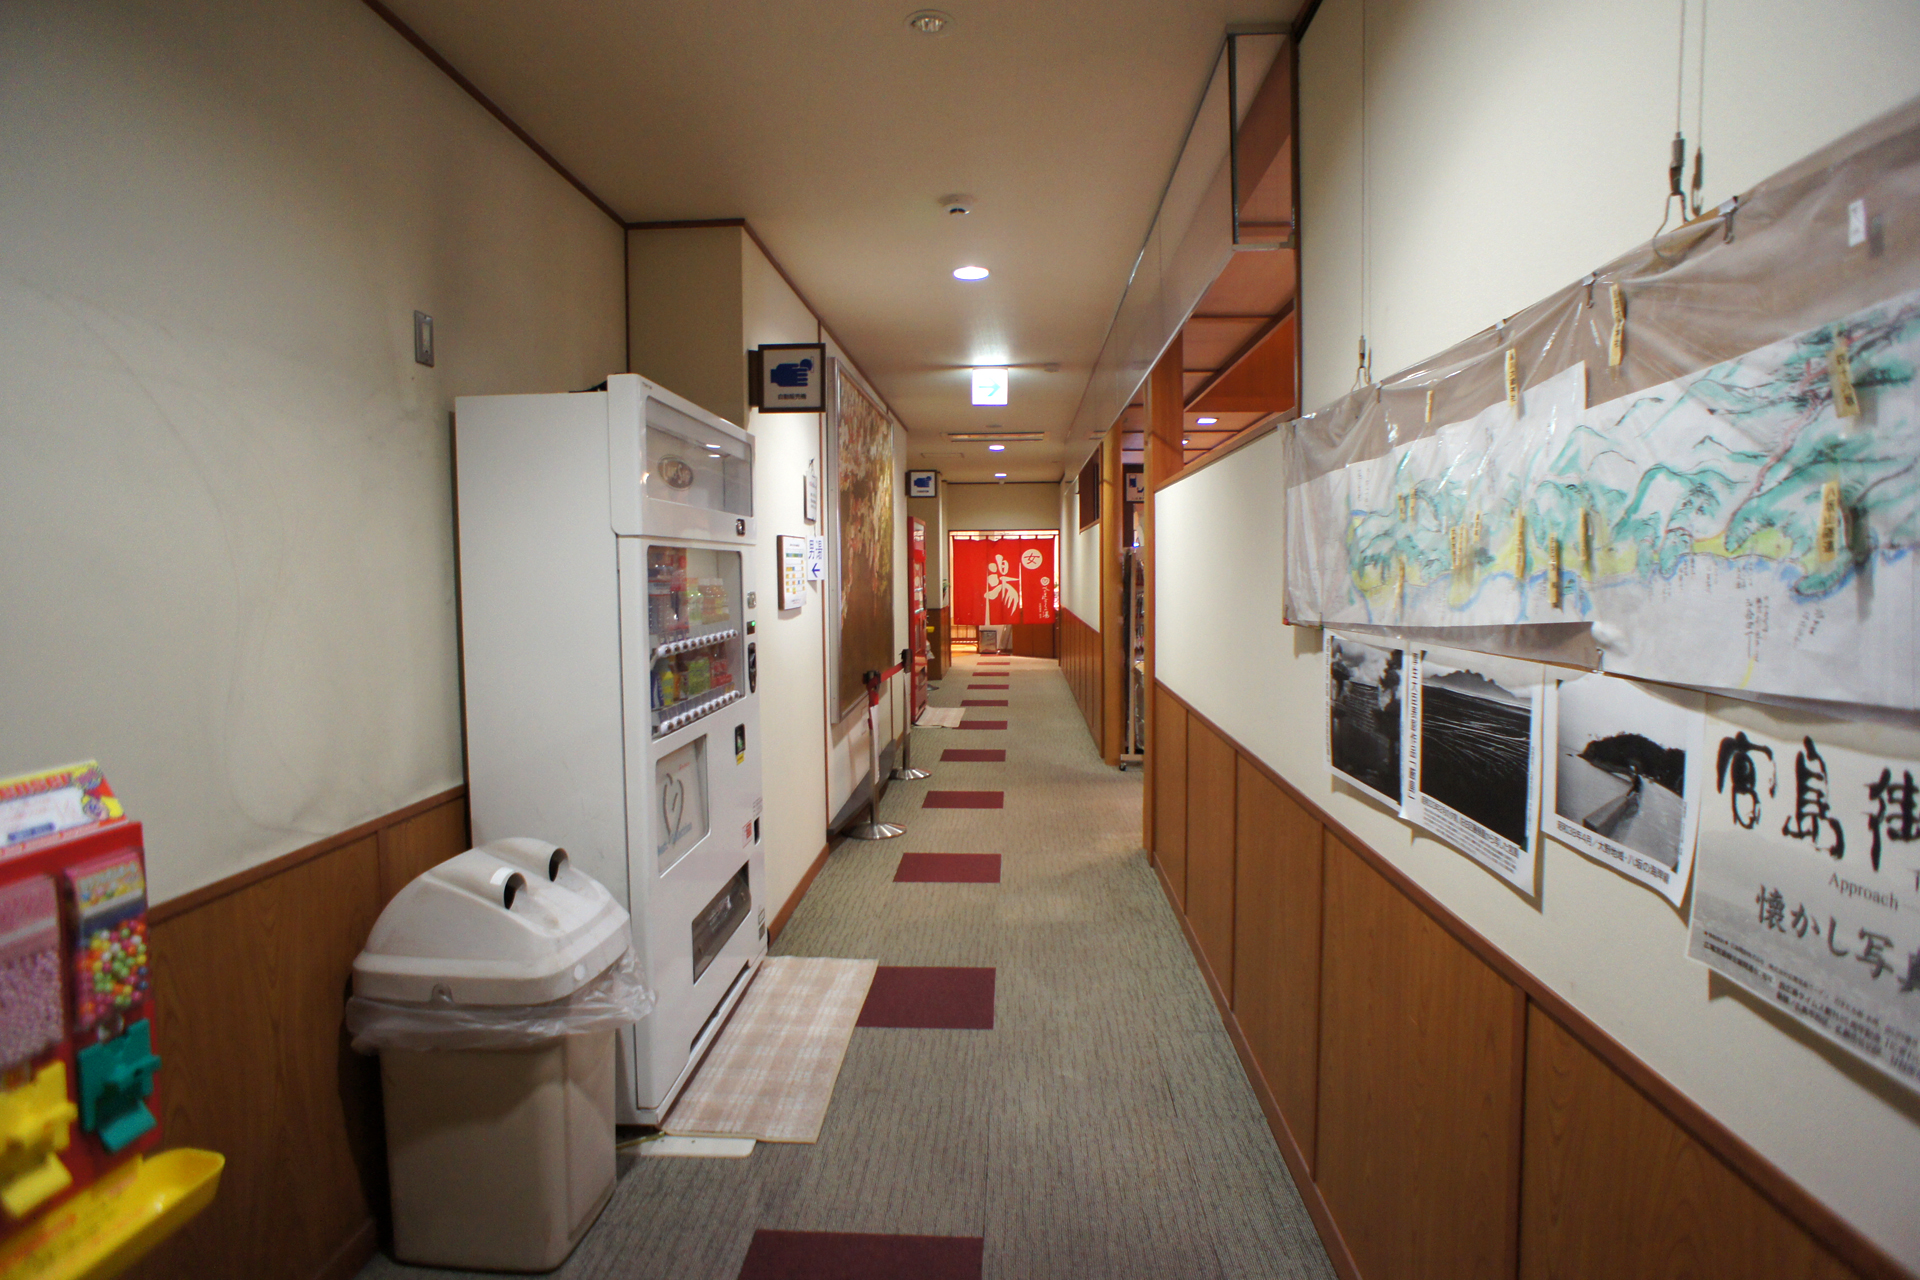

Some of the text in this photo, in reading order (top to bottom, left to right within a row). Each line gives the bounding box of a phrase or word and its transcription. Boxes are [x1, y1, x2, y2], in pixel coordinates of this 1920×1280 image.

[1024, 553, 1040, 565] 女
[984, 554, 1020, 616] 湯
[1828, 872, 1900, 911] Approach
